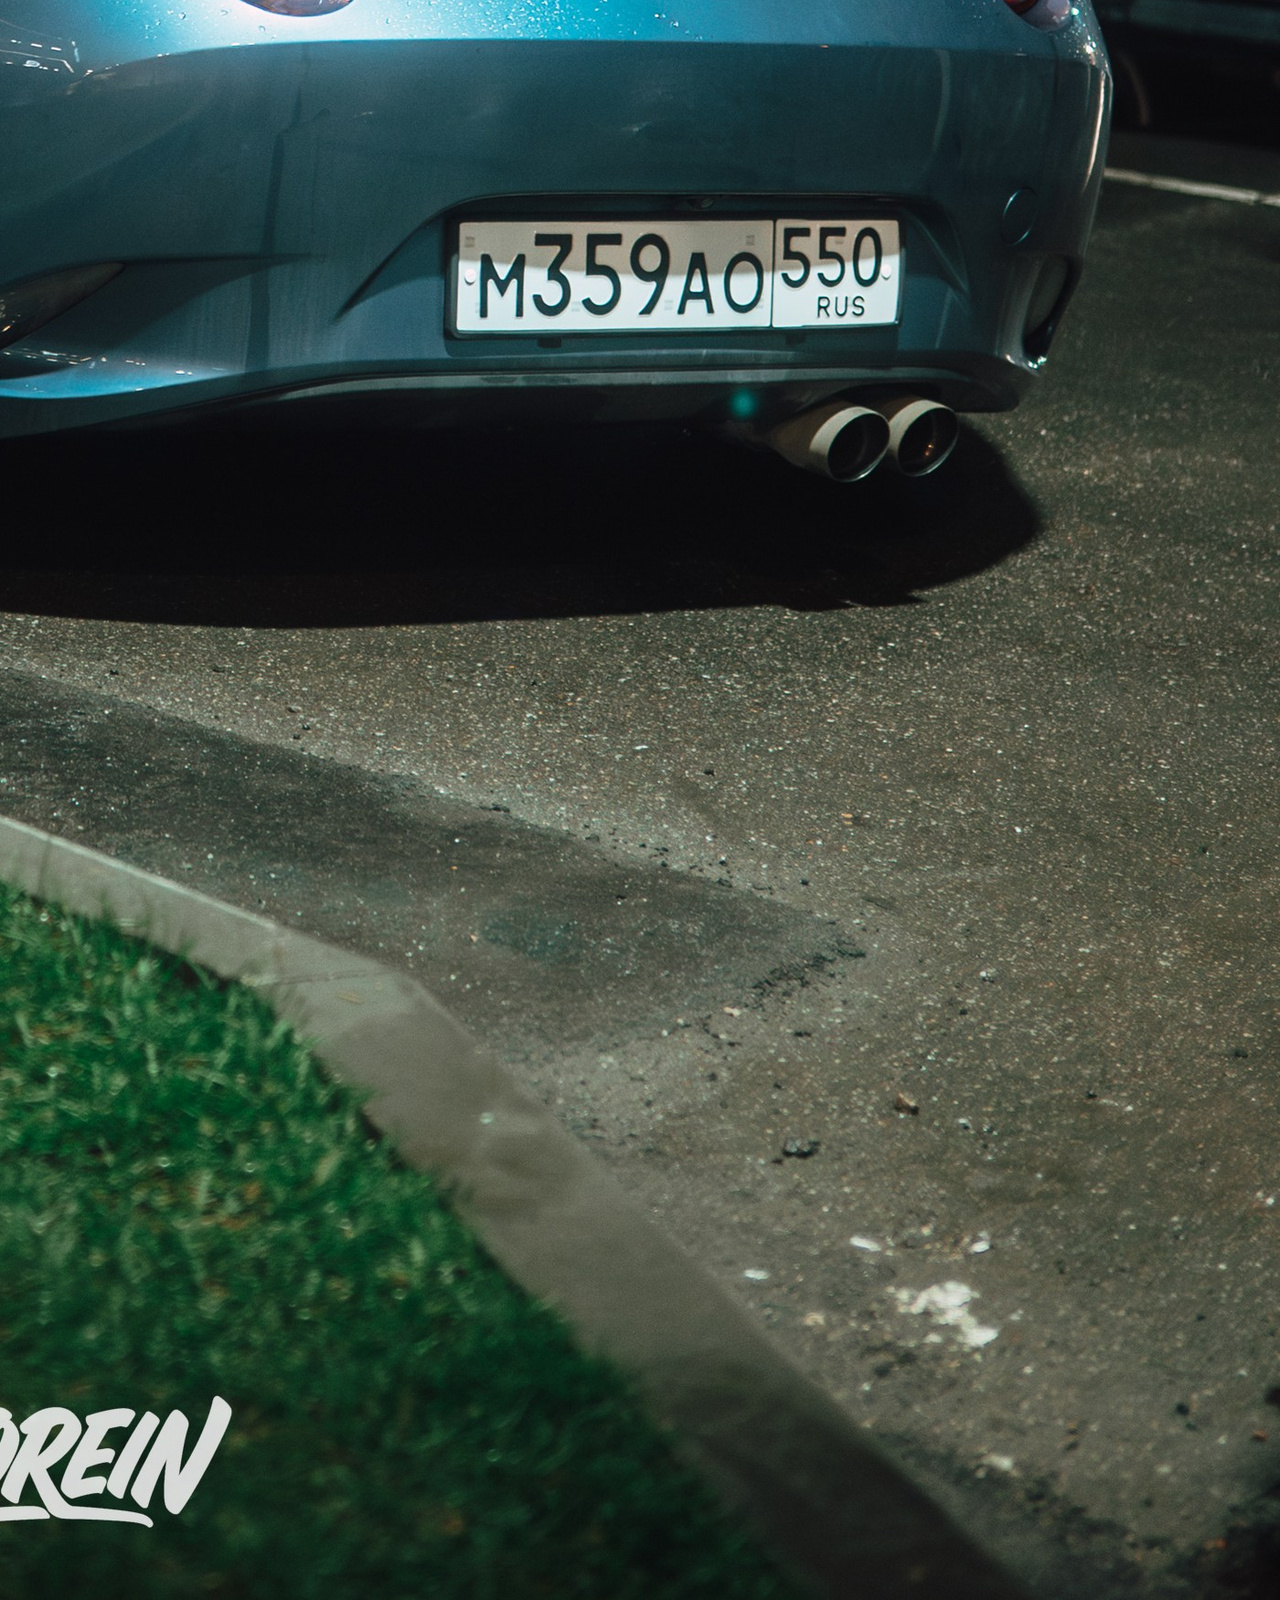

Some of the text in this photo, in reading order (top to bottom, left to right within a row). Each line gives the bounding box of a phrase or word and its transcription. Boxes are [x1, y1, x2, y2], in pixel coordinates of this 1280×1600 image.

[480, 233, 764, 318] М359АО
[781, 227, 882, 288] 550
[817, 295, 865, 317] RUS
